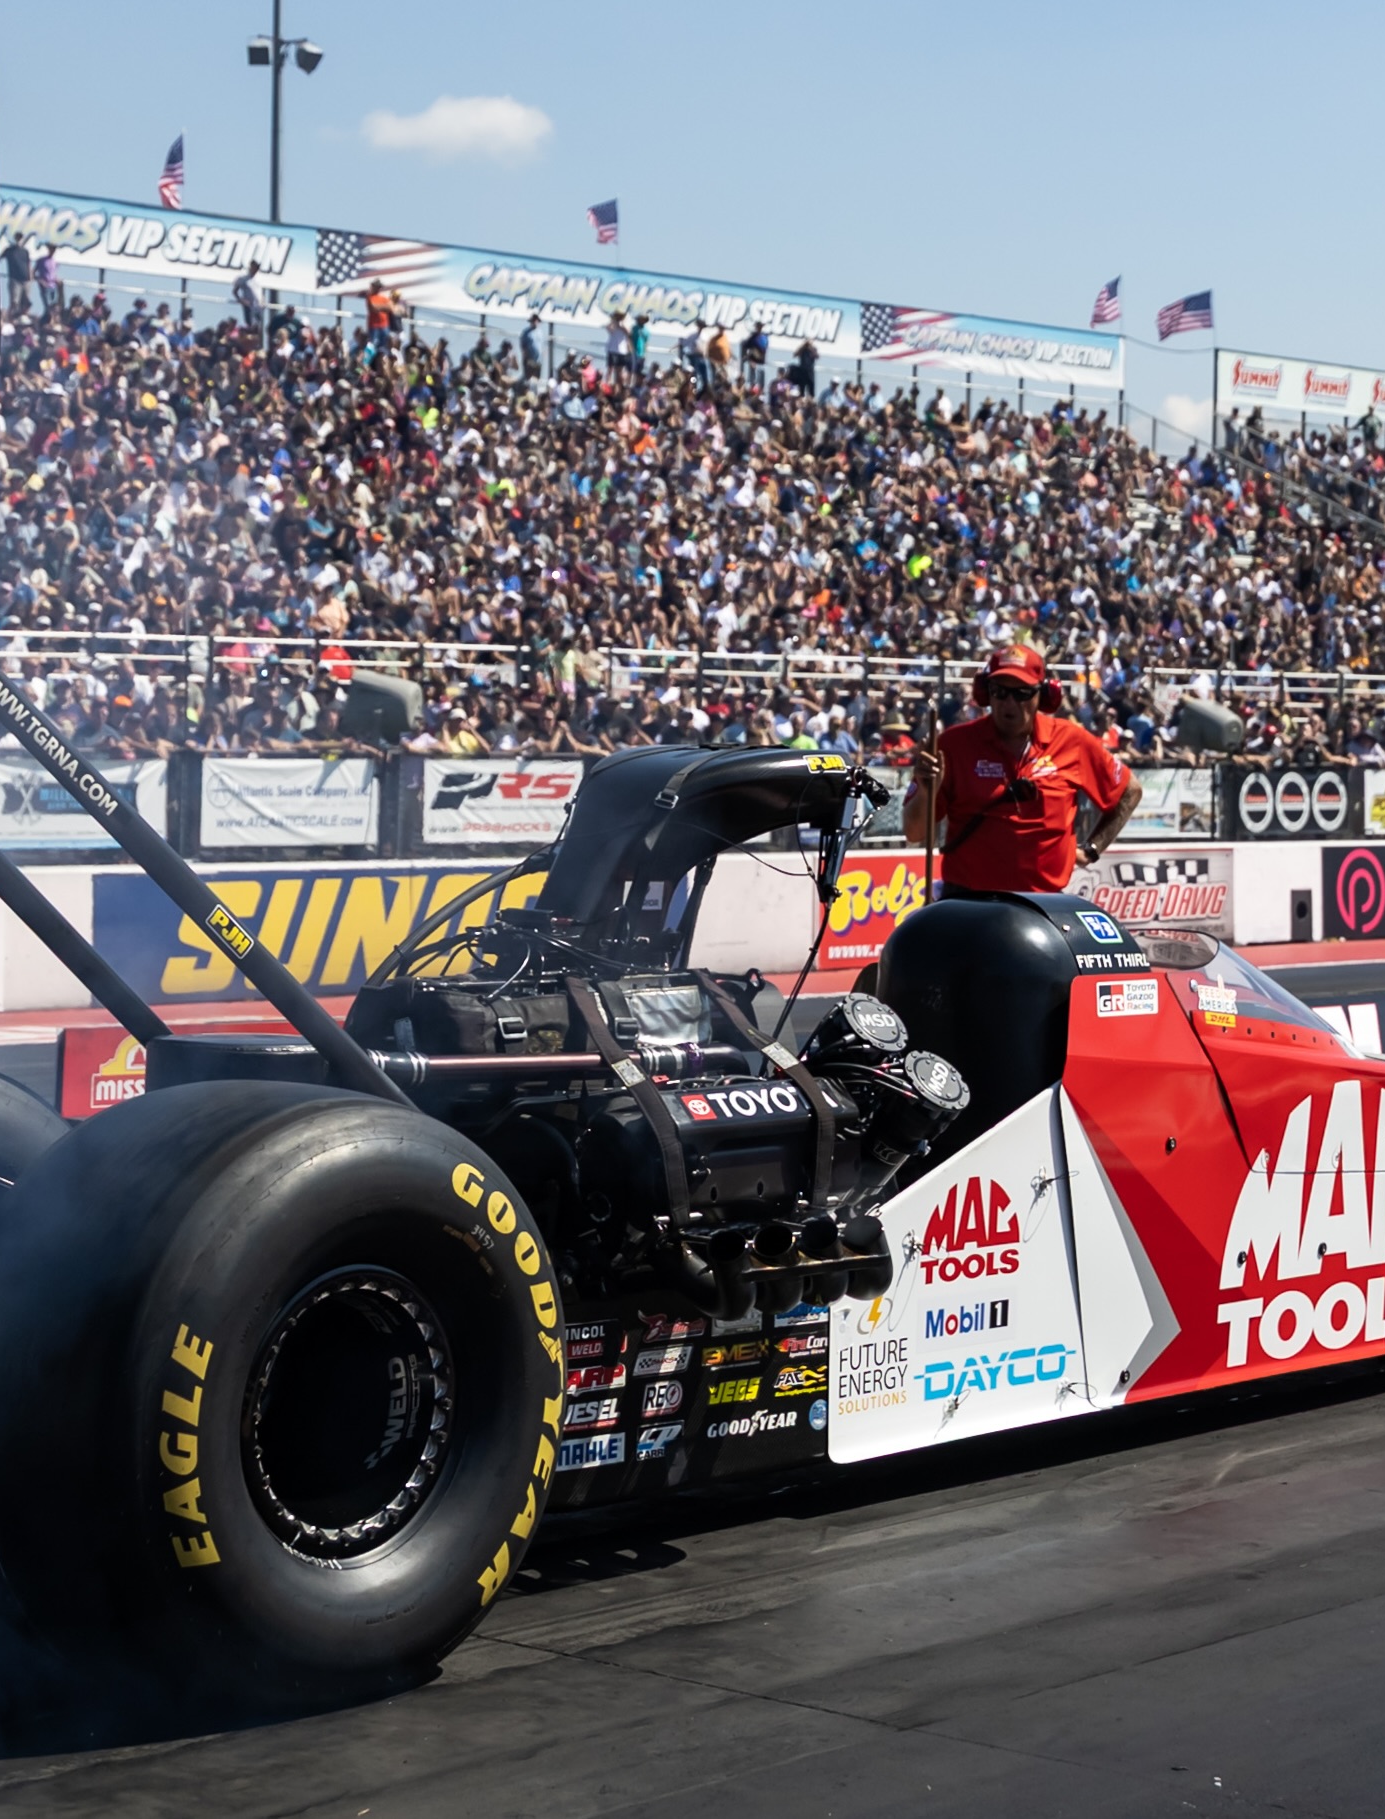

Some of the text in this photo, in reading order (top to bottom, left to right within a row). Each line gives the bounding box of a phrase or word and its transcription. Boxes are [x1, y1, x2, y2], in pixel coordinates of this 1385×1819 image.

[106, 214, 164, 259] VIP
[164, 221, 294, 275] SECTION
[464, 262, 844, 343] CAPTAIN CHAOS VIP SECTION
[903, 325, 1114, 369] CAPTAIN CHAOS VIP SECTION
[809, 756, 844, 770] PJH
[277, 785, 302, 797] Scale
[432, 773, 575, 809] PRS
[1094, 883, 1227, 922] SPEED DAWG
[161, 871, 550, 994] SUNO
[210, 909, 251, 954] PJH
[1076, 954, 1112, 968] FIFTH
[1126, 983, 1156, 992] TOYOTA
[1127, 993, 1154, 1001] GAZOO
[858, 1013, 896, 1029] MSD
[1127, 1002, 1154, 1012] Racing
[1198, 1000, 1237, 1013] AMERICA
[1210, 1015, 1231, 1024] DHL
[926, 1062, 950, 1097] MSD
[922, 1176, 1020, 1251] MAC
[920, 1248, 1020, 1284] TOOLS
[565, 1325, 606, 1341] INCOL
[925, 1300, 1009, 1339] Mobil 1
[839, 1338, 908, 1371] FUTURE
[452, 1163, 564, 1606] GOODYEAR
[566, 1364, 626, 1390] ARP
[774, 1371, 806, 1388] PAC
[838, 1365, 908, 1398] ENERGY
[916, 1345, 1075, 1401] DAYCO
[380, 1356, 408, 1448] WELD
[708, 1377, 762, 1404] JEGS
[838, 1390, 907, 1416] SOLUTIONS
[565, 1398, 620, 1425] IESEL
[707, 1408, 797, 1438] GOODYEAR
[159, 1323, 221, 1568] EAGLE
[558, 1439, 618, 1467] MAHLE
[637, 1449, 666, 1460] CARR
